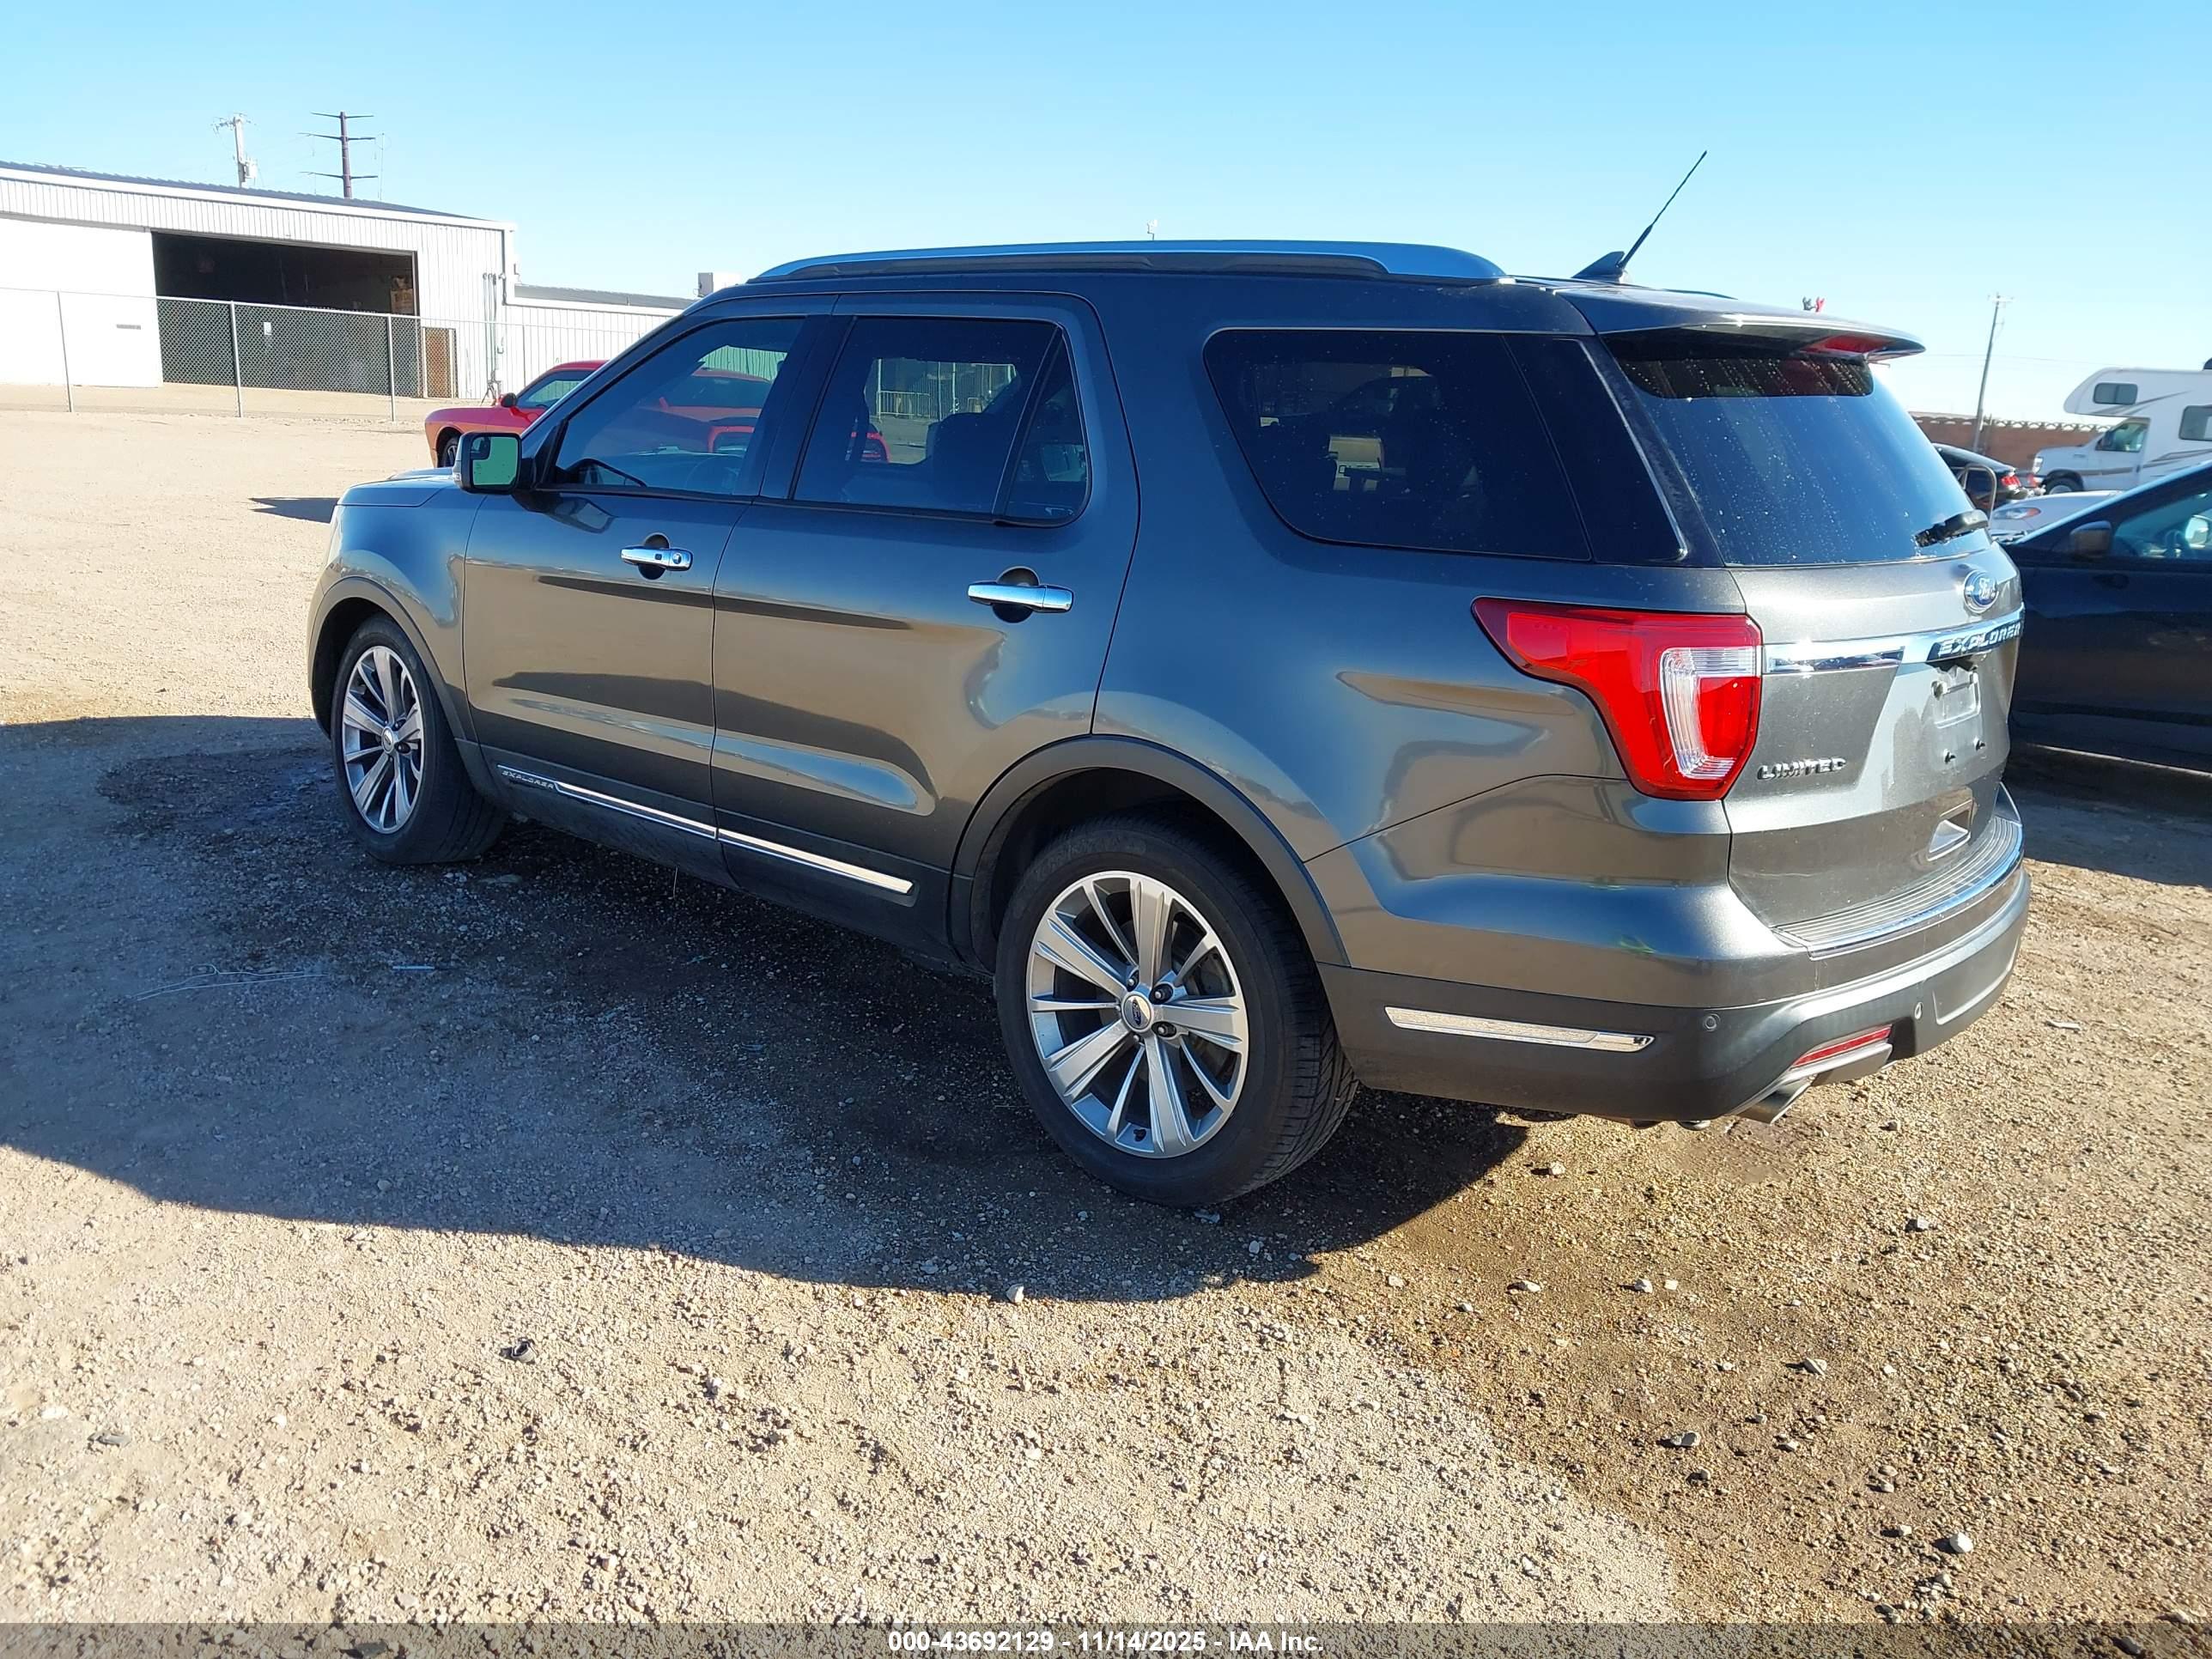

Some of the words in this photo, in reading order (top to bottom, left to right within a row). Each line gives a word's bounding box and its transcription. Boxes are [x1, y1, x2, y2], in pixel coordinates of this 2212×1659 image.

[1938, 622, 2021, 655] EXPLORER
[501, 769, 554, 789] EXPLORER
[1757, 757, 1846, 780] LIMITED
